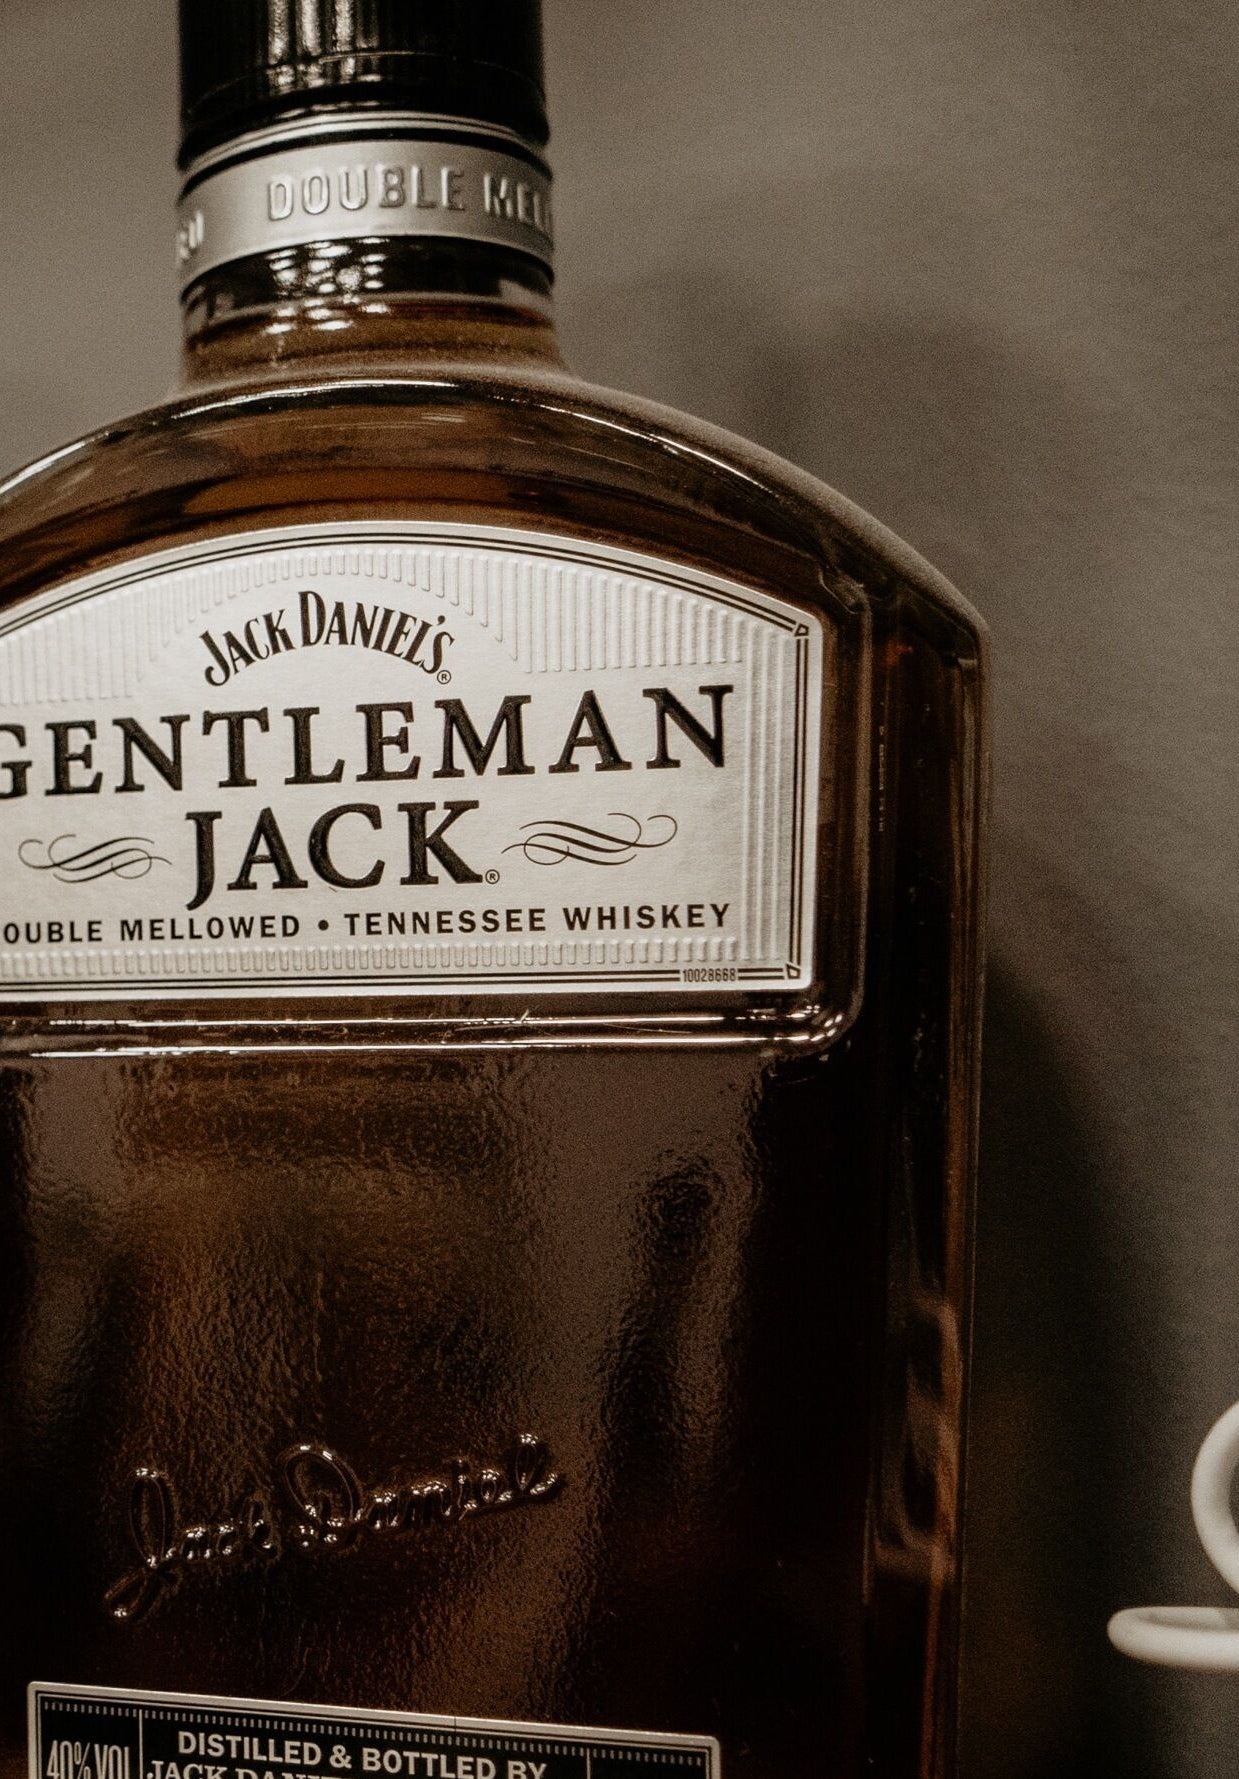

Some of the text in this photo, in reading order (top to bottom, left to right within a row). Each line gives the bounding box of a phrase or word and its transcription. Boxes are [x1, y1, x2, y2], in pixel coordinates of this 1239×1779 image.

[267, 163, 466, 221] DOUBLE
[199, 608, 295, 687] JACK
[186, 800, 484, 911] JACK
[120, 915, 300, 942] MELLOWED
[344, 908, 546, 936] TENNESSEE
[563, 903, 730, 931] WHISKEY
[682, 967, 737, 982] 10028668
[177, 1730, 322, 1766] DISTILLED
[329, 1744, 352, 1769] &
[362, 1747, 496, 1779] BOTTLED
[507, 1760, 547, 1779] BY
